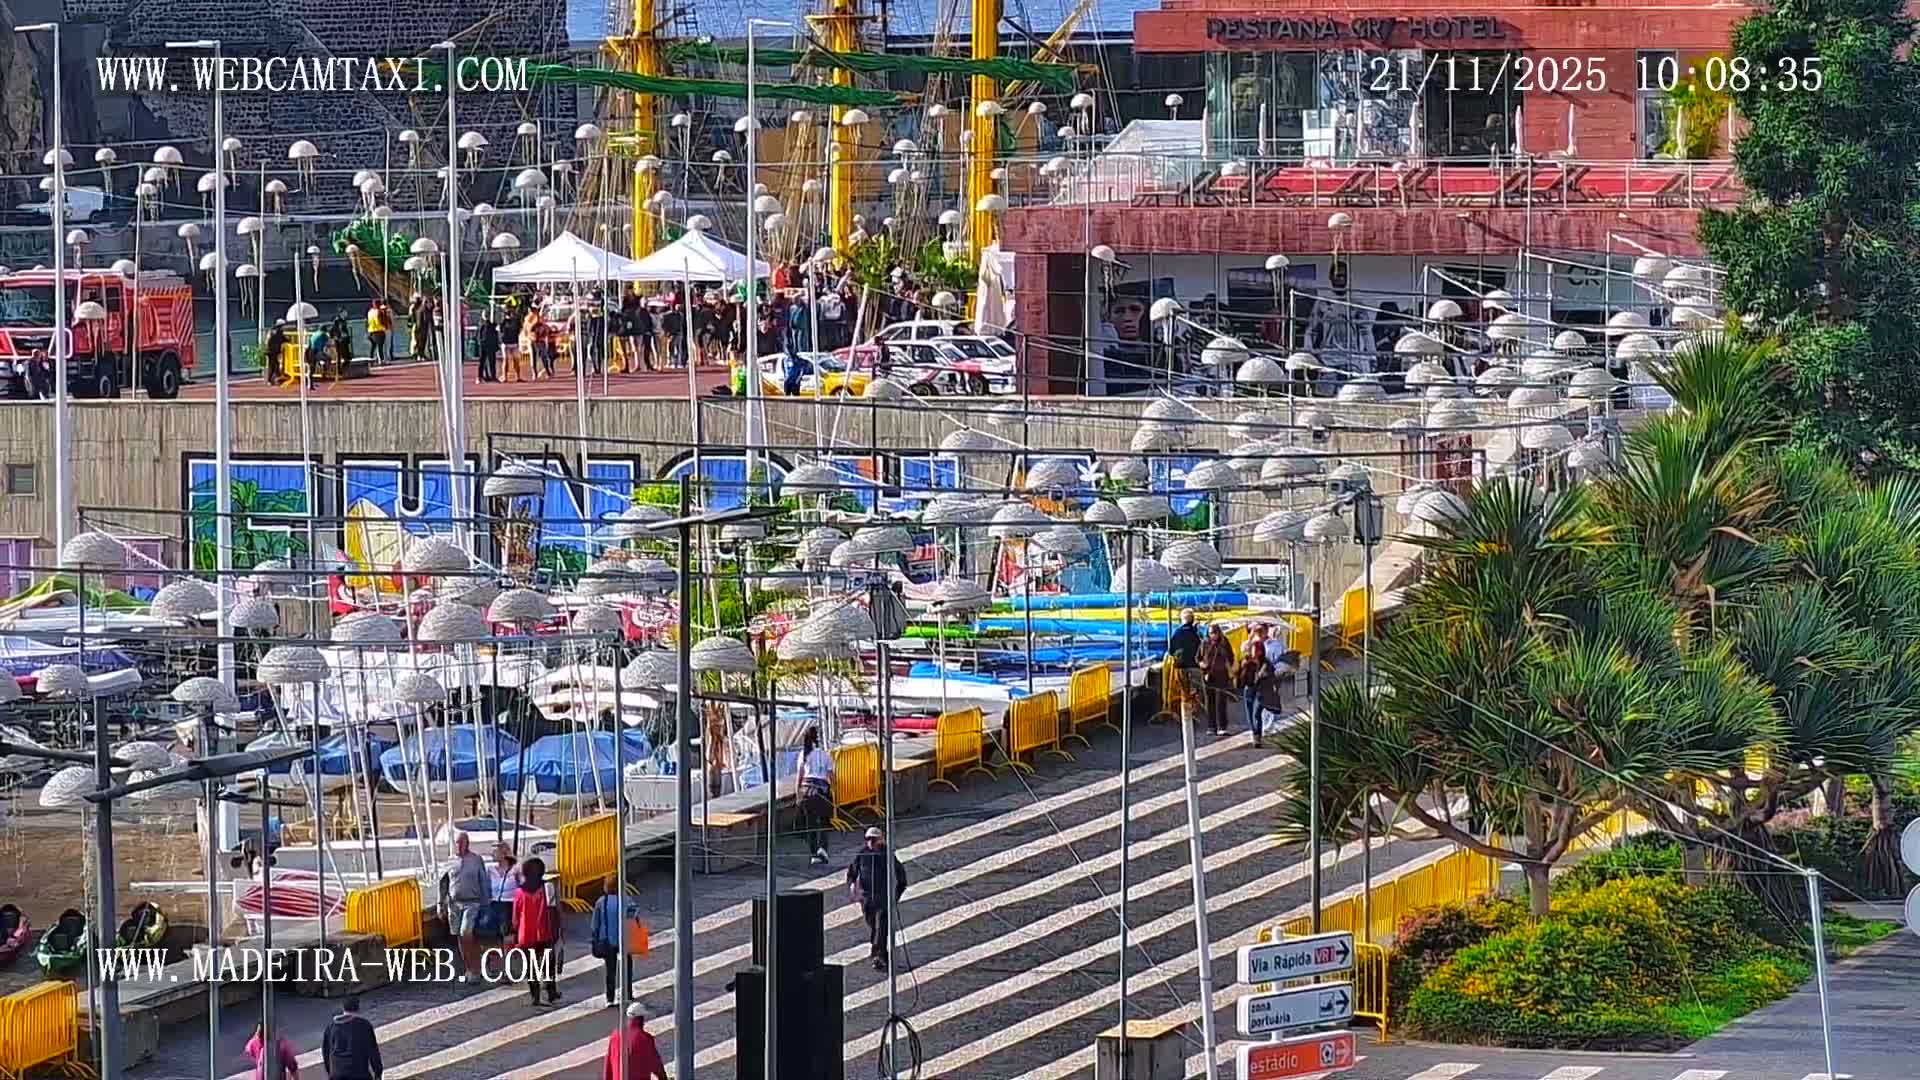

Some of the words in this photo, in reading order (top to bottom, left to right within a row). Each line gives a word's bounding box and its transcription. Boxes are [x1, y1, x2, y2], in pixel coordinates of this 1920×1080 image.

[1206, 17, 1338, 40] PESTANA
[1408, 16, 1506, 39] HOTEL
[1251, 957, 1269, 973] Via
[1274, 949, 1312, 971] Rápida
[1251, 1001, 1271, 1013] zona
[1251, 1013, 1291, 1029] portuária
[1250, 1048, 1298, 1074] estádio
